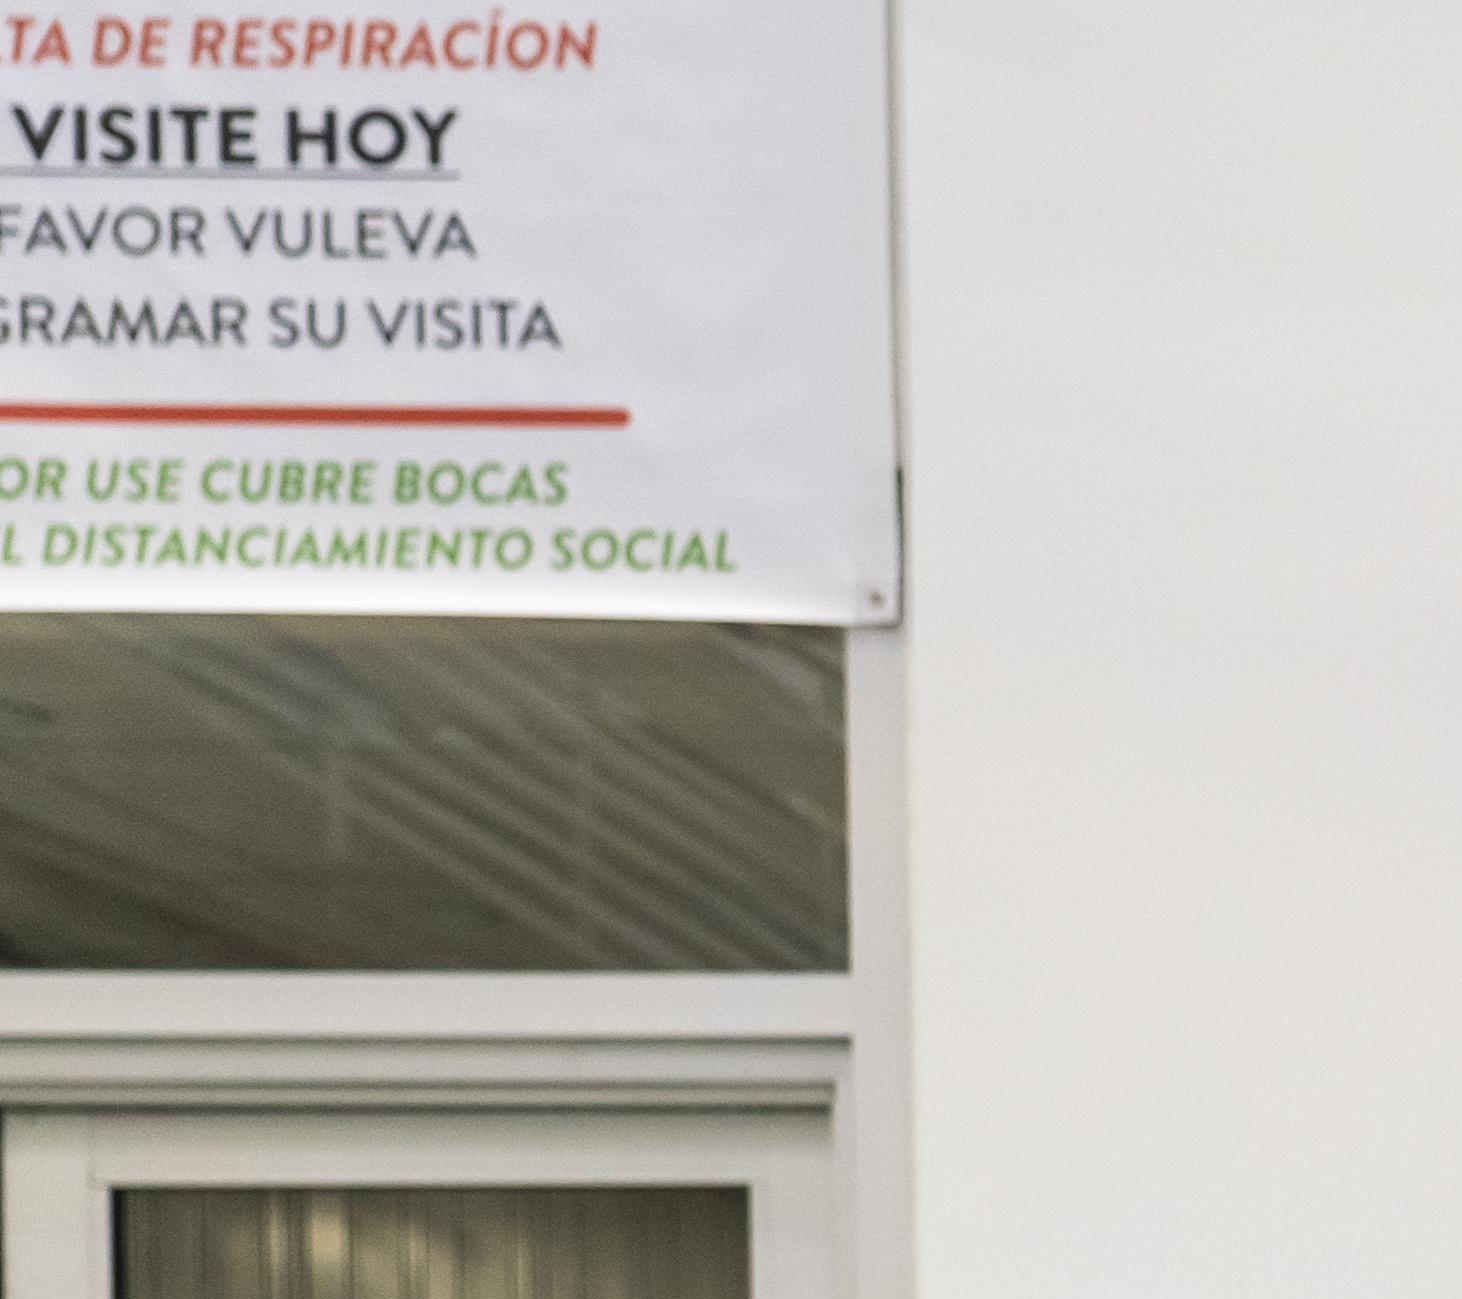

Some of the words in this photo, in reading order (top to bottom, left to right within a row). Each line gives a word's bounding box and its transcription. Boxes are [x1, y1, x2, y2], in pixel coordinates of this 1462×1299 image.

[6, 17, 71, 66] TA
[92, 17, 170, 67] DE
[190, 9, 598, 71] RESPIRACÍON
[12, 105, 257, 164] VISITE
[287, 108, 458, 165] HOY
[226, 206, 477, 260] VULEVA
[268, 298, 347, 348] SU
[368, 300, 562, 350] VISITA
[87, 458, 183, 503] USE
[200, 459, 375, 505] CUBRE
[394, 462, 570, 507] BOCAS
[43, 524, 533, 570] DISTANCIAMIENTO
[548, 529, 738, 573] SOCIAL
